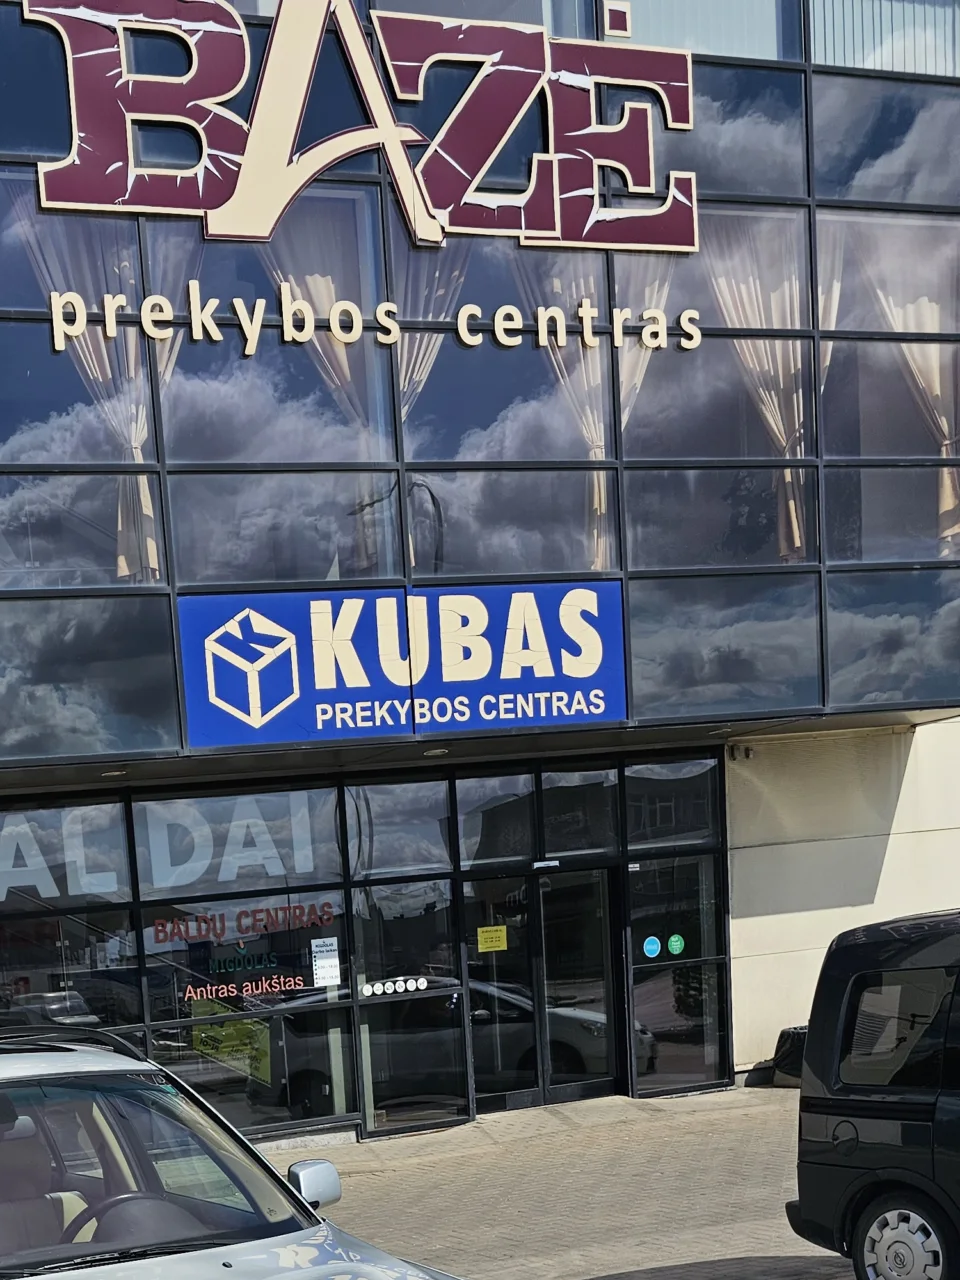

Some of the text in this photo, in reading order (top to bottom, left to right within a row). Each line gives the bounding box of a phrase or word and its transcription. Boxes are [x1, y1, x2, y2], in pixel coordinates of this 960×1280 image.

[49, 279, 703, 356] prekybos centras
[310, 588, 604, 690] KUBAS
[315, 690, 606, 730] PREKYBOS CENTRAS
[153, 901, 335, 944] BALDŲ CENTRAS
[208, 952, 278, 974] MIGDOLAS
[184, 975, 305, 1001] Antras aukštas
